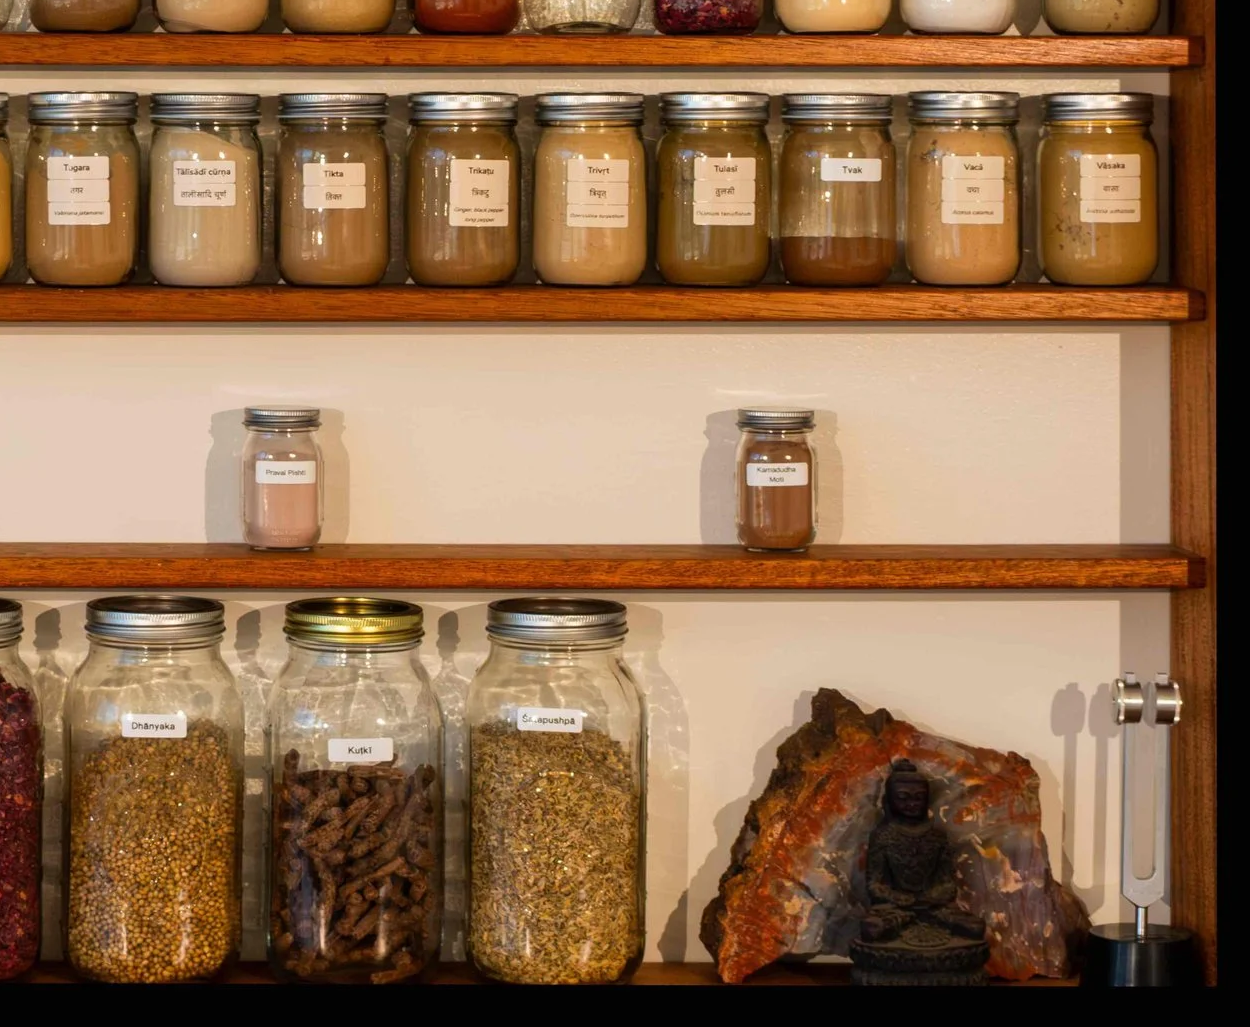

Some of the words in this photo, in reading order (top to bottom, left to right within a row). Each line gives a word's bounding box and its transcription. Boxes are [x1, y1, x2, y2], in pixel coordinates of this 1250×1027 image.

[324, 170, 344, 178] Tikta
[843, 166, 862, 174] Tvak
[132, 722, 175, 730] Dhānyaka
